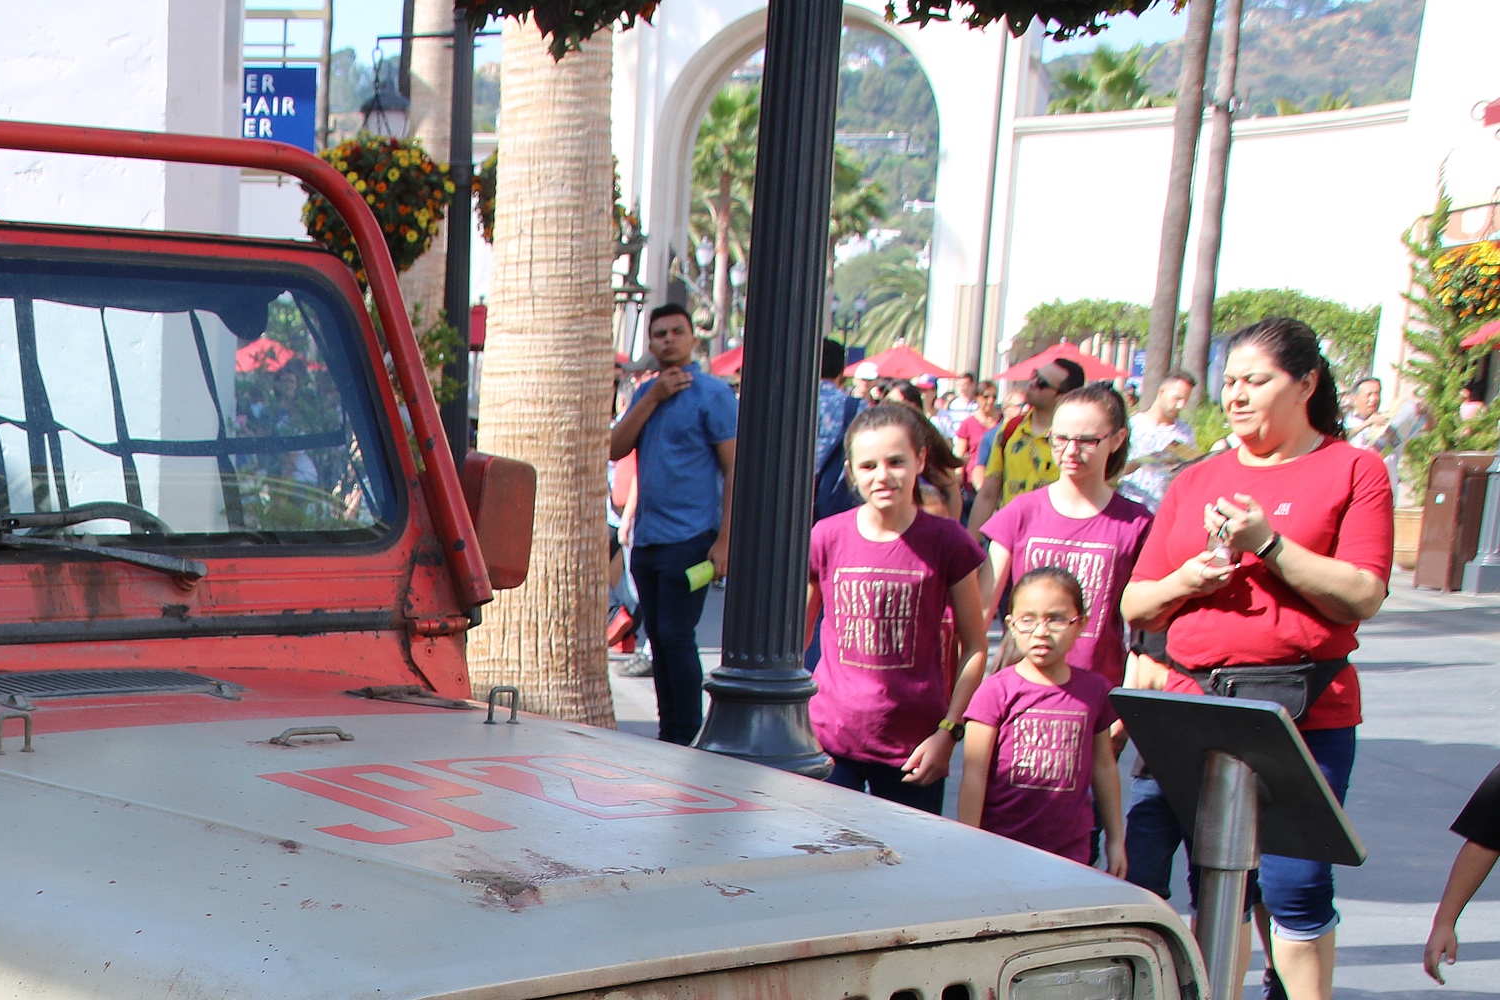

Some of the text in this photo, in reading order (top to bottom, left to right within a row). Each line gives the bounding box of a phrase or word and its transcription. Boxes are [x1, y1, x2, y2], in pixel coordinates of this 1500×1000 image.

[840, 579, 914, 619] SISTER
[843, 617, 909, 656] #CREW
[1019, 717, 1082, 749] SISTER
[256, 763, 518, 845] JP
